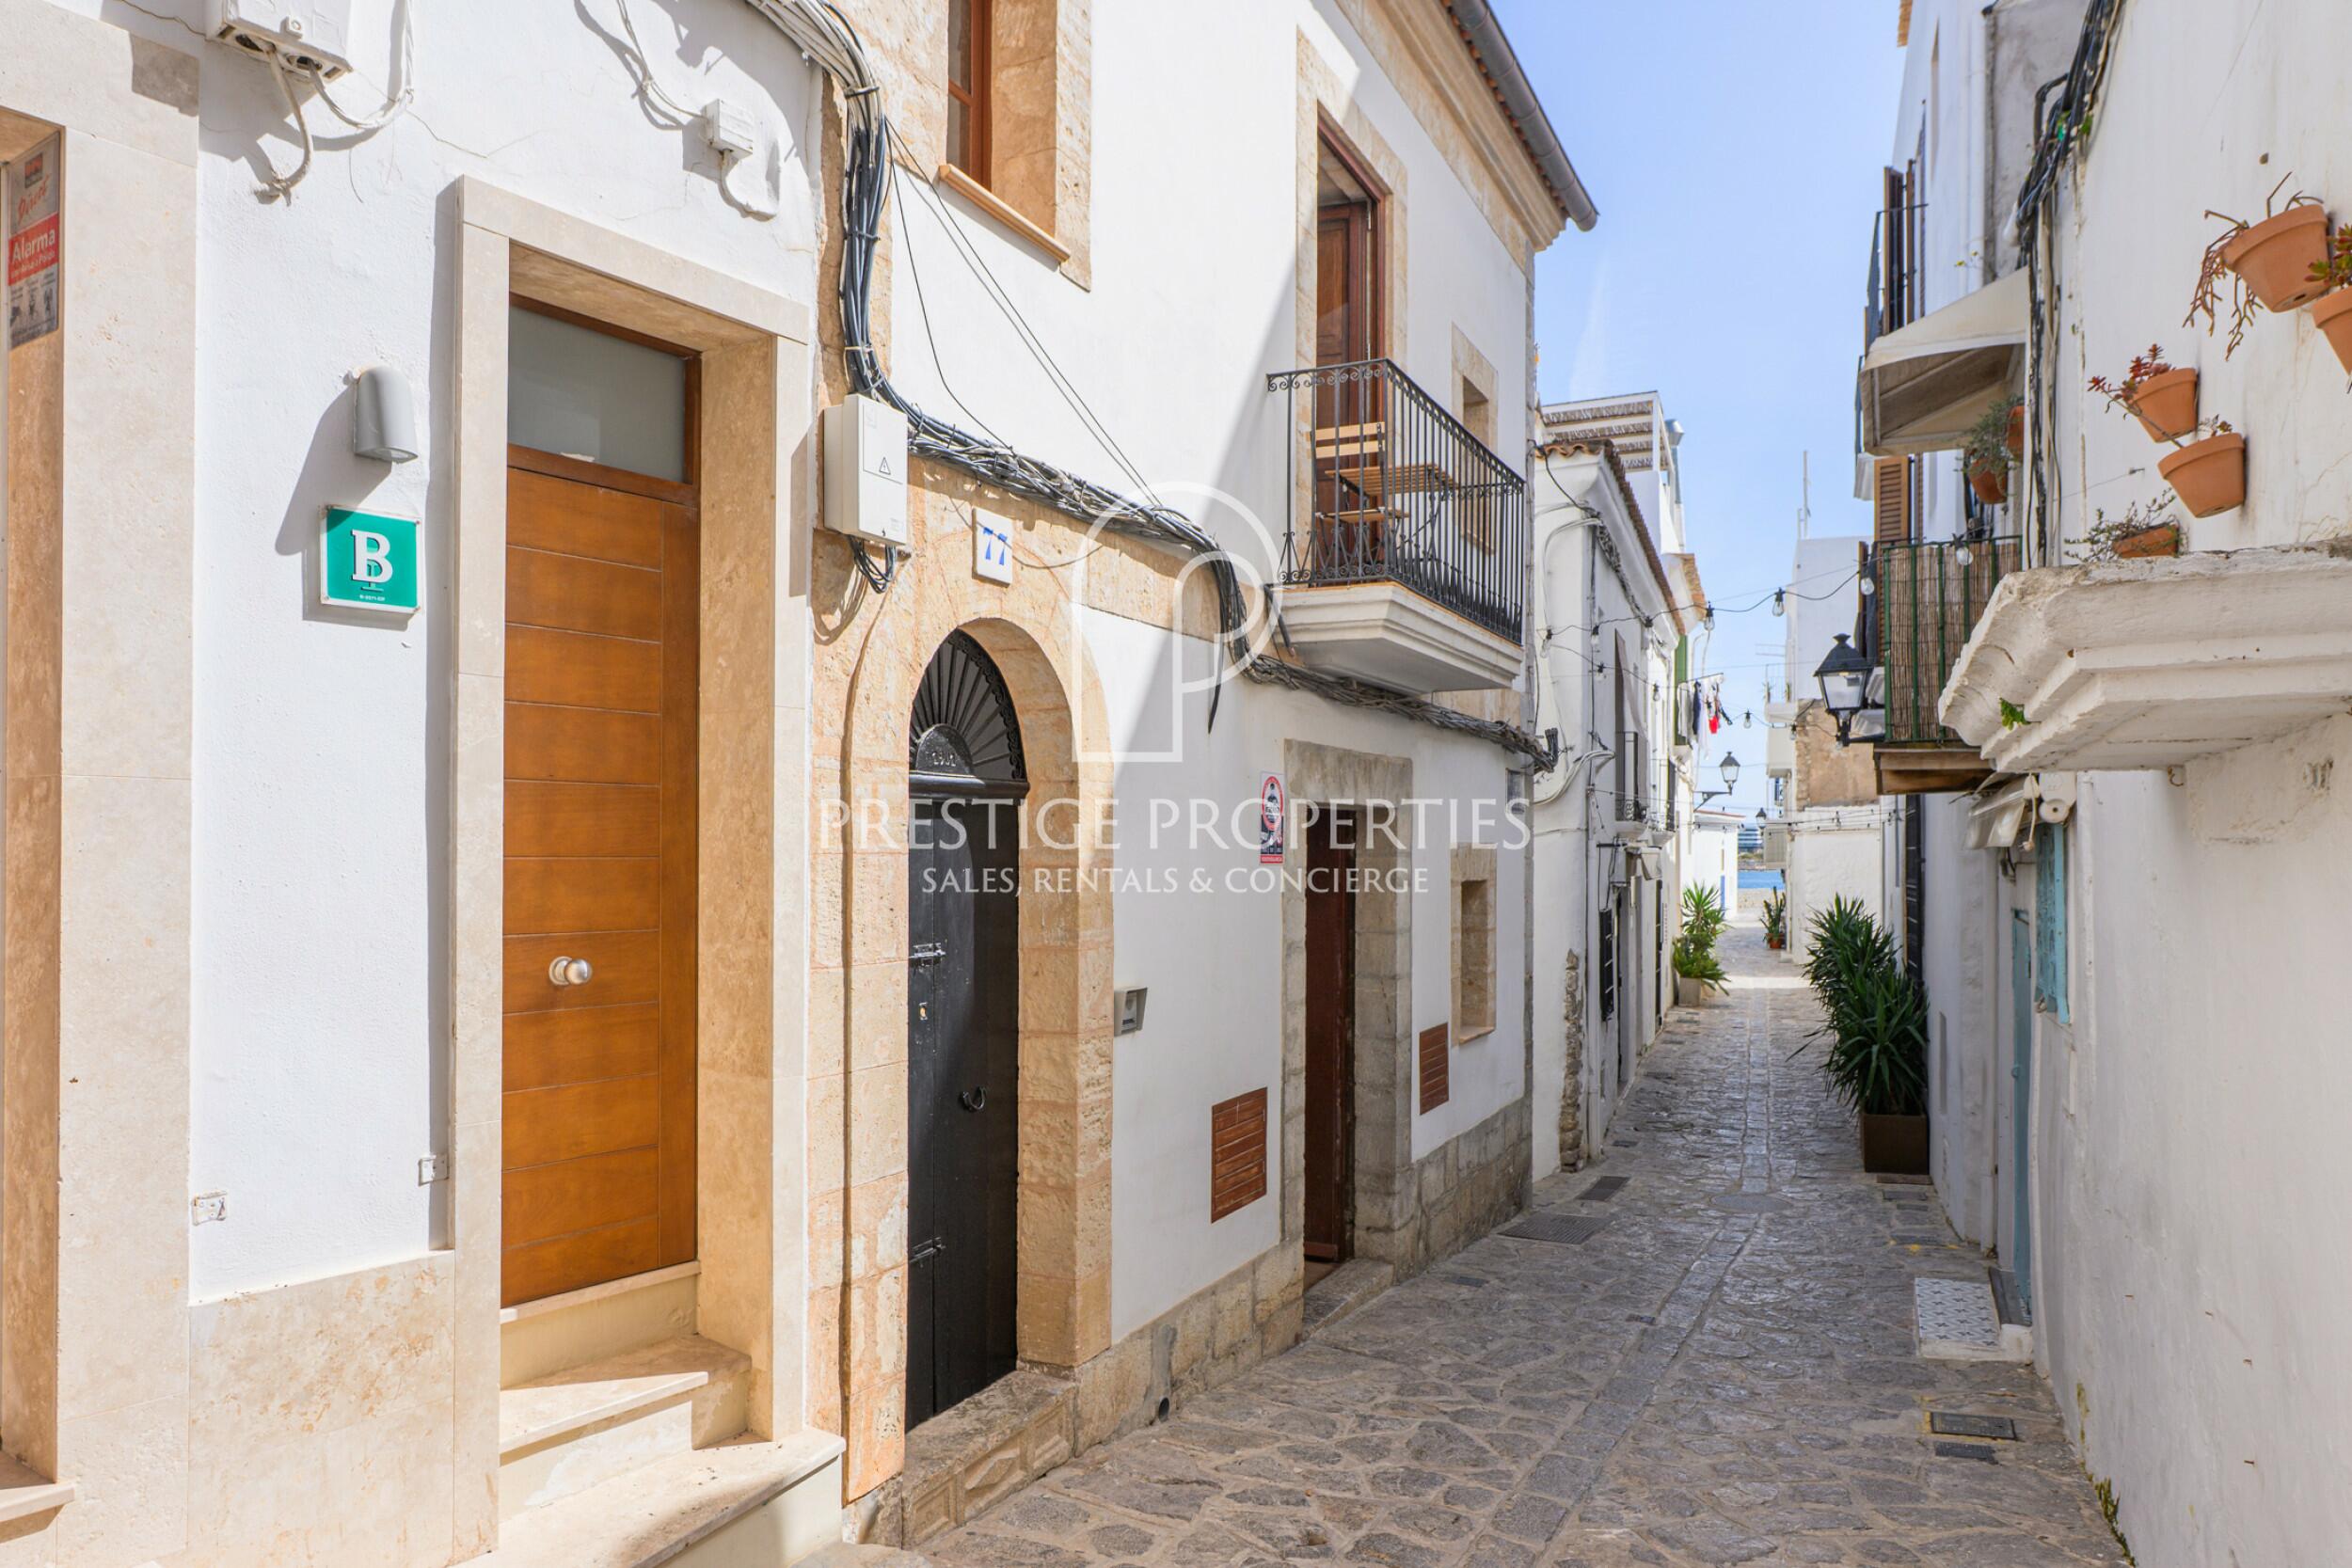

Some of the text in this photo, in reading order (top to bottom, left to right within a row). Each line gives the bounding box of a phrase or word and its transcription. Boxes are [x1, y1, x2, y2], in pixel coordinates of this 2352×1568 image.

[11, 229, 56, 264] Alarma
[351, 529, 393, 584] B
[983, 527, 1008, 565] 77
